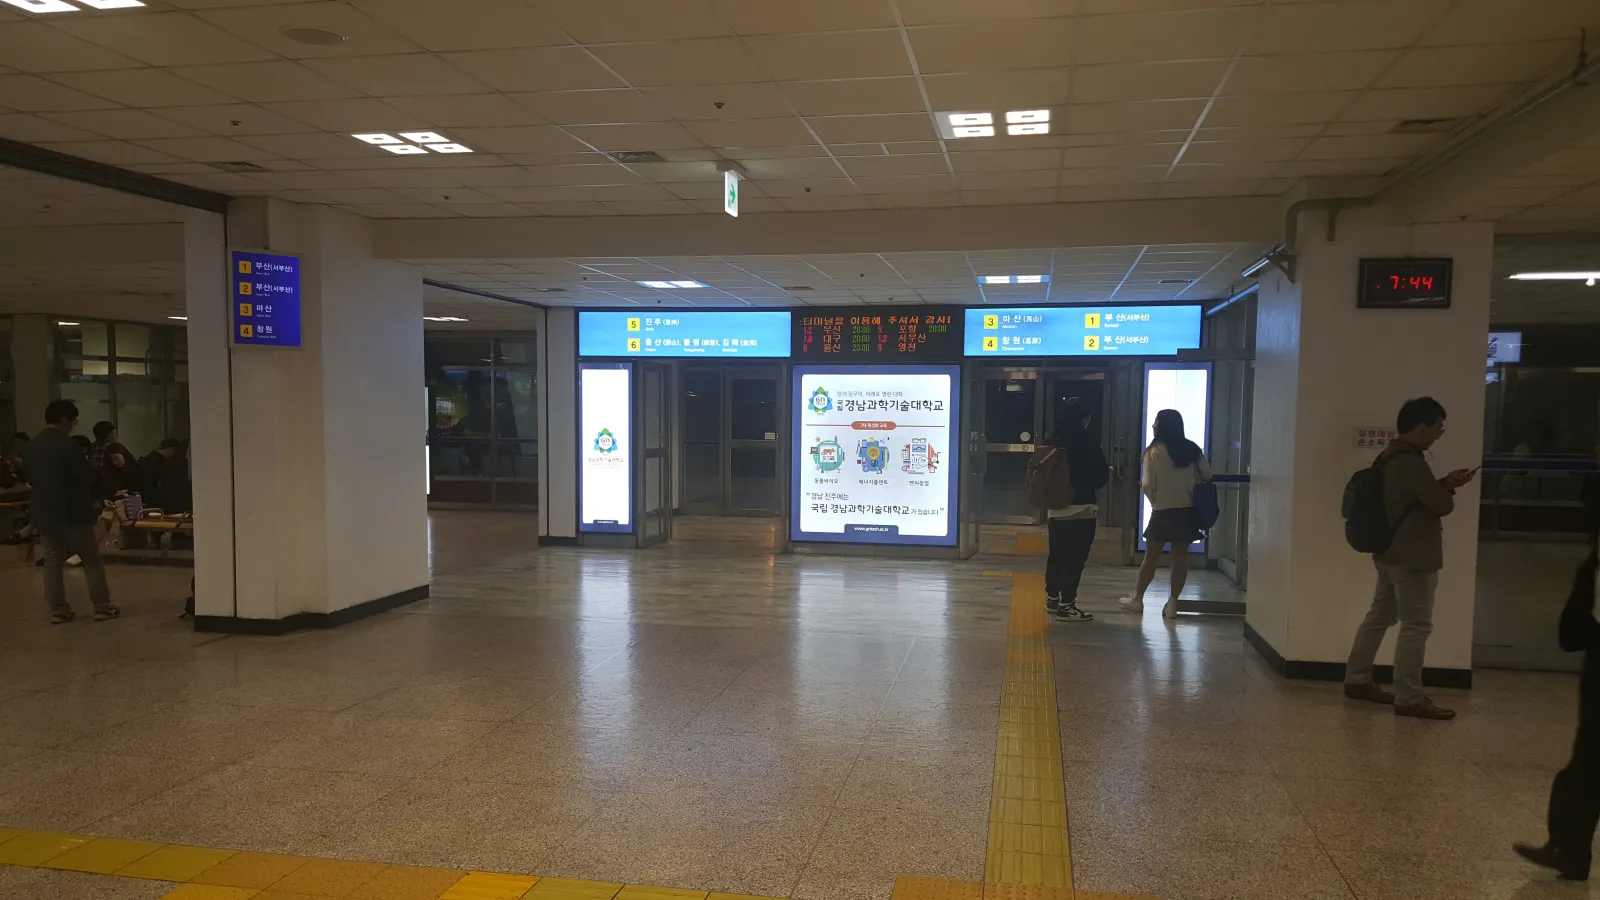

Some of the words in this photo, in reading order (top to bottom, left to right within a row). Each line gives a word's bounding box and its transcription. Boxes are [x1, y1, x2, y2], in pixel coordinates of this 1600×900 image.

[1390, 275, 1433, 290] 7:44
[243, 285, 249, 293] 2
[243, 306, 249, 314] 3
[631, 320, 637, 328] 5
[850, 316, 881, 325] 이용해
[888, 316, 919, 325] 주셔서
[988, 318, 994, 326] 3
[243, 327, 249, 335] 4
[852, 326, 870, 334] 20:00
[899, 325, 916, 333] 포항
[928, 325, 946, 333] 20:00
[823, 335, 841, 344] 대구
[852, 335, 870, 343] 20:00
[1088, 339, 1095, 347] 2
[631, 341, 637, 349] 6
[823, 344, 841, 352] 울산
[852, 344, 870, 352] 20:00
[987, 340, 993, 348] 4
[845, 399, 944, 412] 경남과학기술대학교
[824, 493, 850, 501] 진주에는
[811, 504, 828, 514] 국립
[830, 504, 910, 515] 경남과학기술대학교
